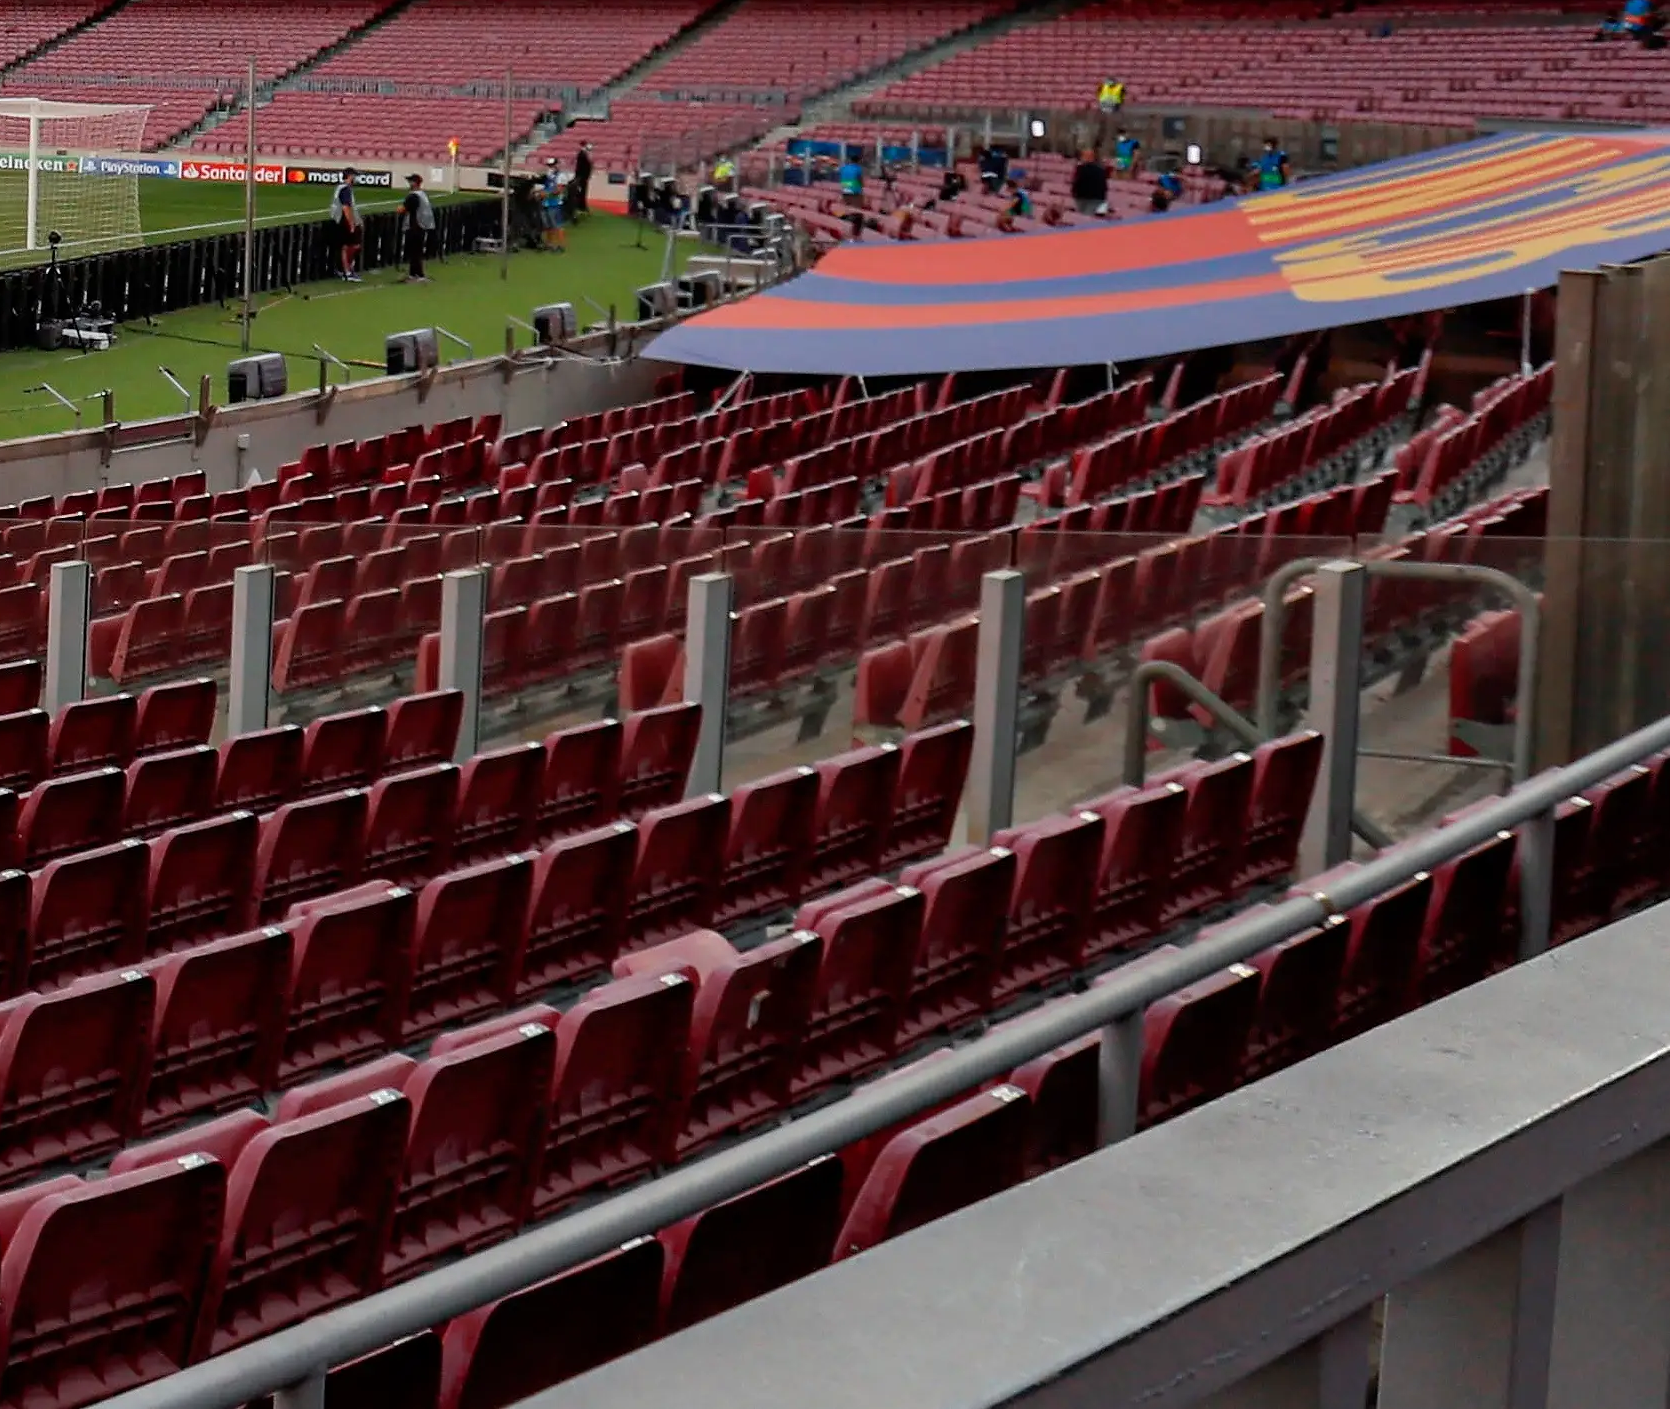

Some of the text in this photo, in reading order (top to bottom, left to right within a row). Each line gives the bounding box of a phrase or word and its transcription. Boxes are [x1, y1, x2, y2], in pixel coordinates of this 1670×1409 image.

[101, 159, 160, 175] PlayStation
[201, 165, 281, 182] Santader
[308, 171, 390, 186] mastcard
